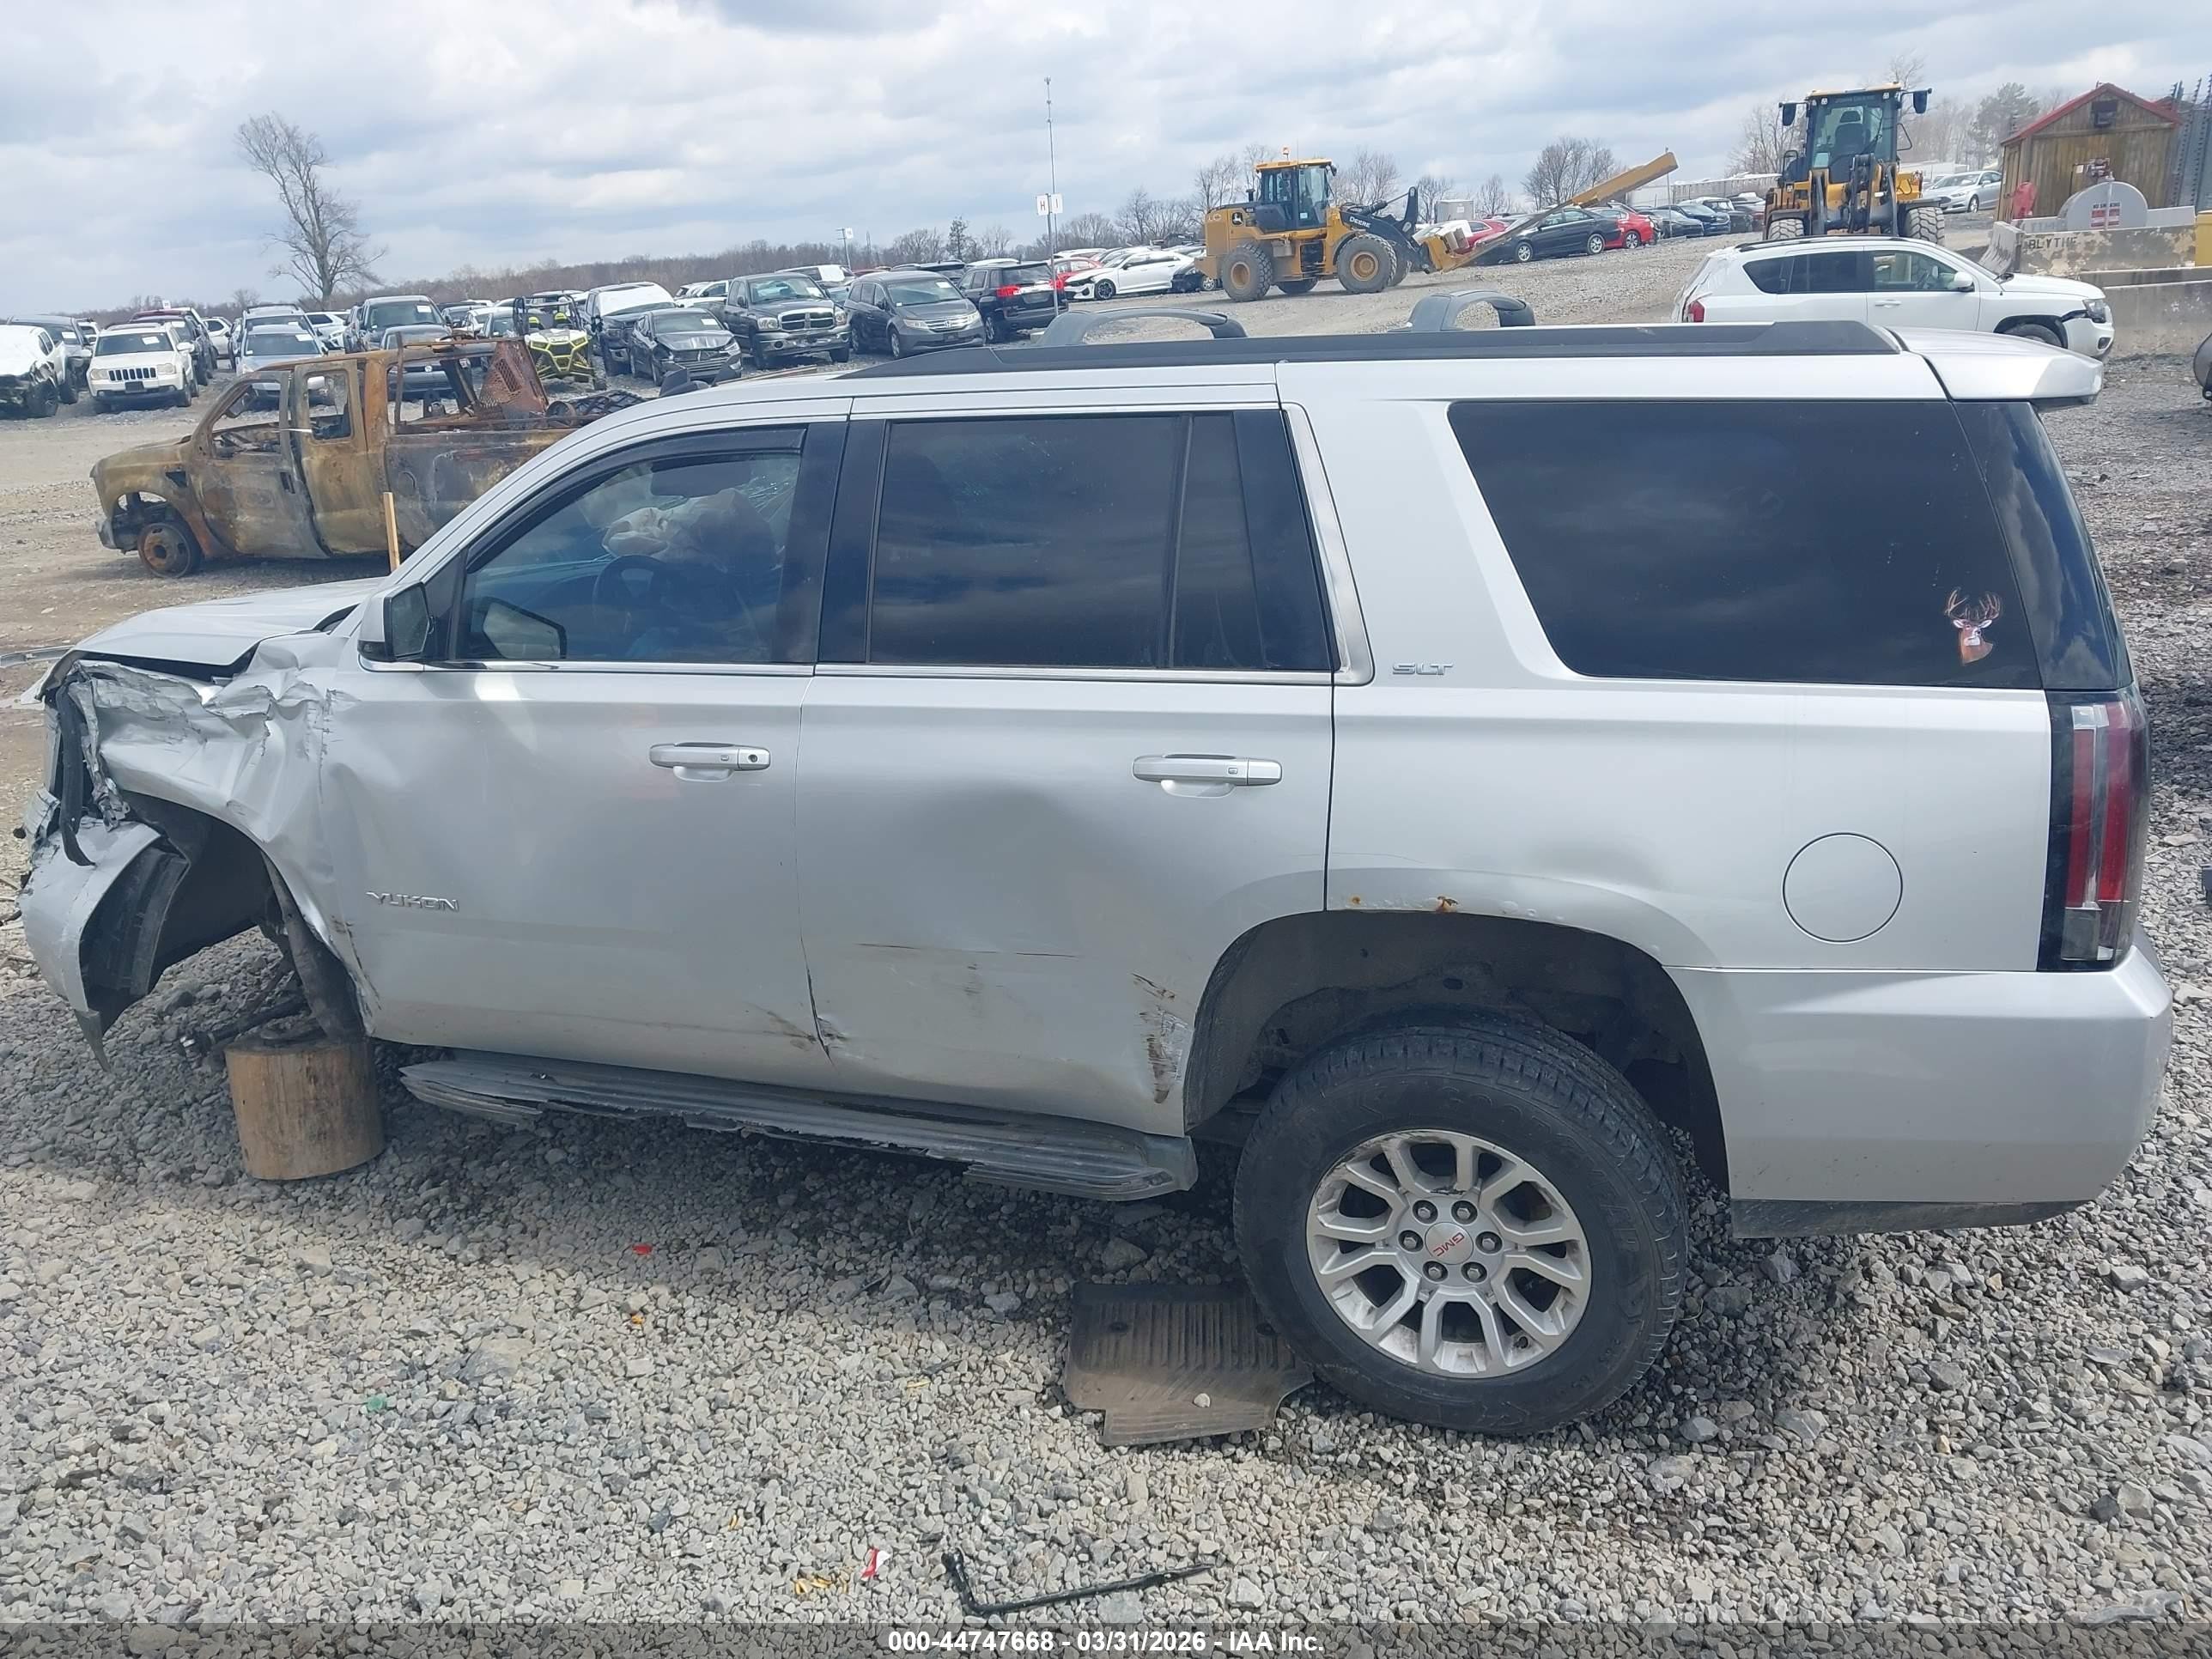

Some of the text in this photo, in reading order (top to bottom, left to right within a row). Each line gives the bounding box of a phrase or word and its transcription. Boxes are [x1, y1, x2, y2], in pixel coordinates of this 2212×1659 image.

[1040, 200, 1046, 211] H
[1349, 216, 1371, 228] DEERE
[1392, 662, 1454, 676] SLT
[365, 890, 460, 913] YUKON
[1432, 1231, 1465, 1257] GMC
